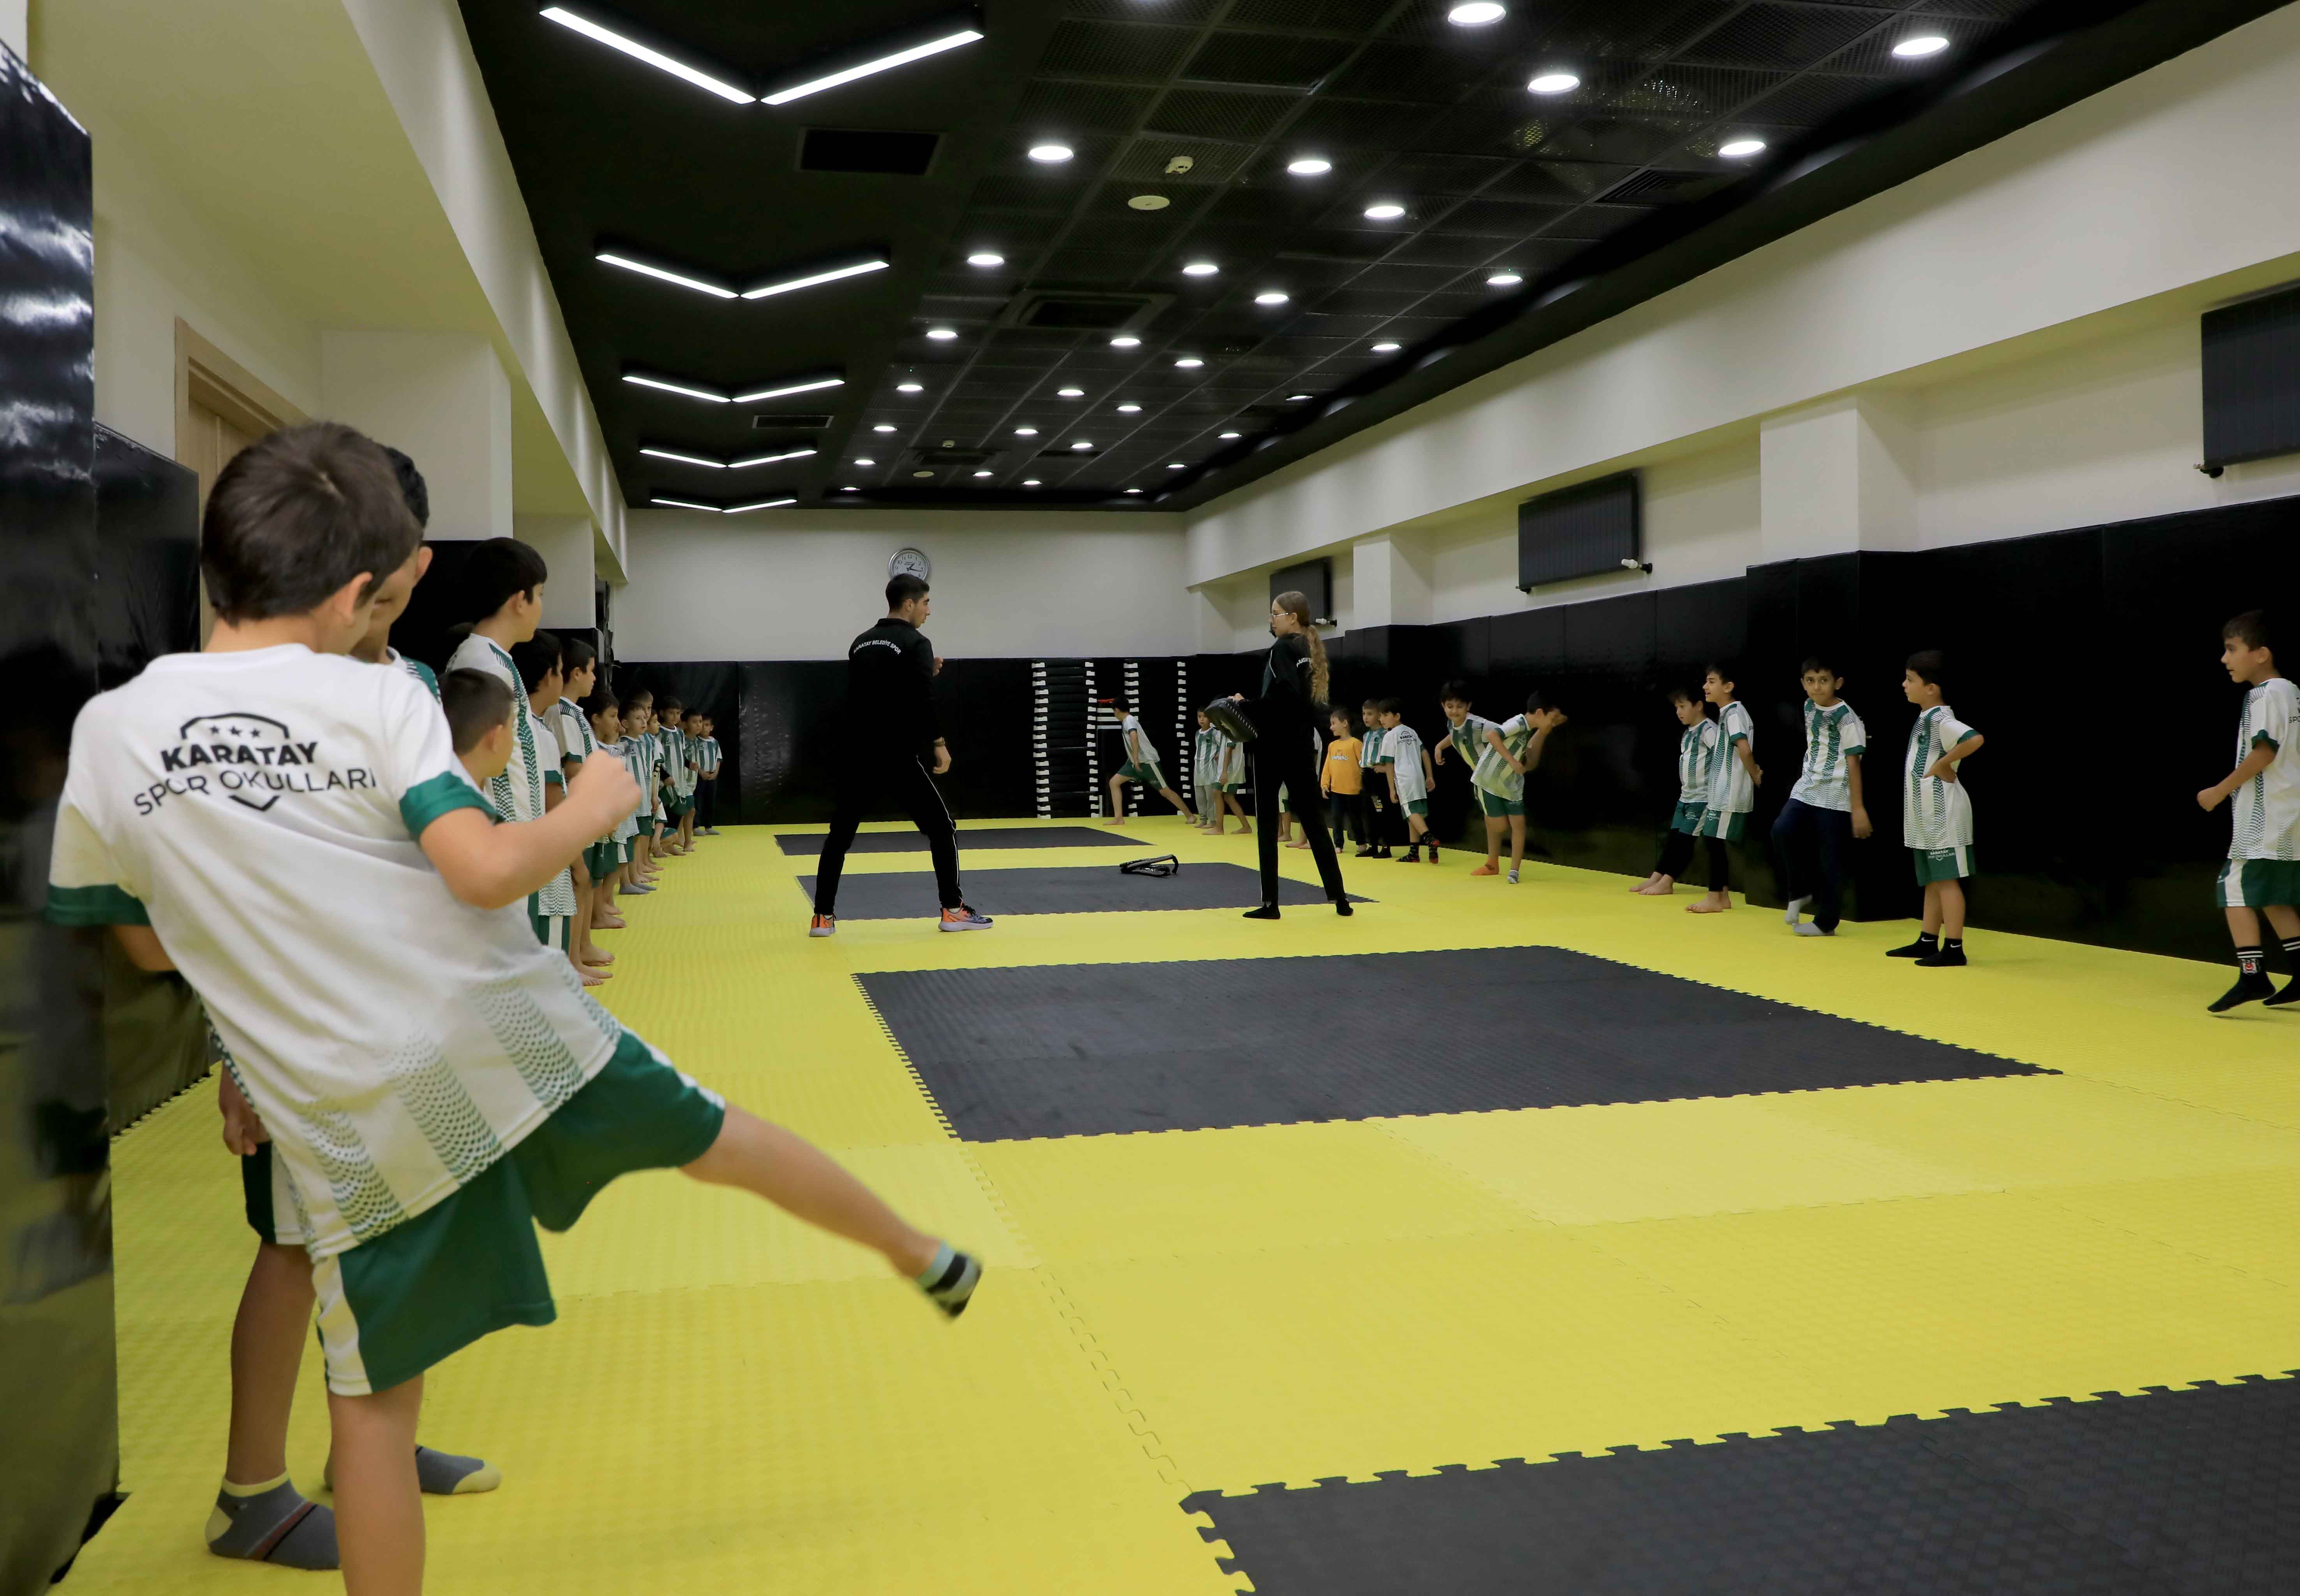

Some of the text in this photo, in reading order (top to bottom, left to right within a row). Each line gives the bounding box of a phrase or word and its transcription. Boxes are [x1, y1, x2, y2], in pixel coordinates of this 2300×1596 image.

[890, 643, 901, 654] SPOR
[161, 742, 318, 772] KARATAY
[134, 767, 376, 816] SPOR OKULLARI
